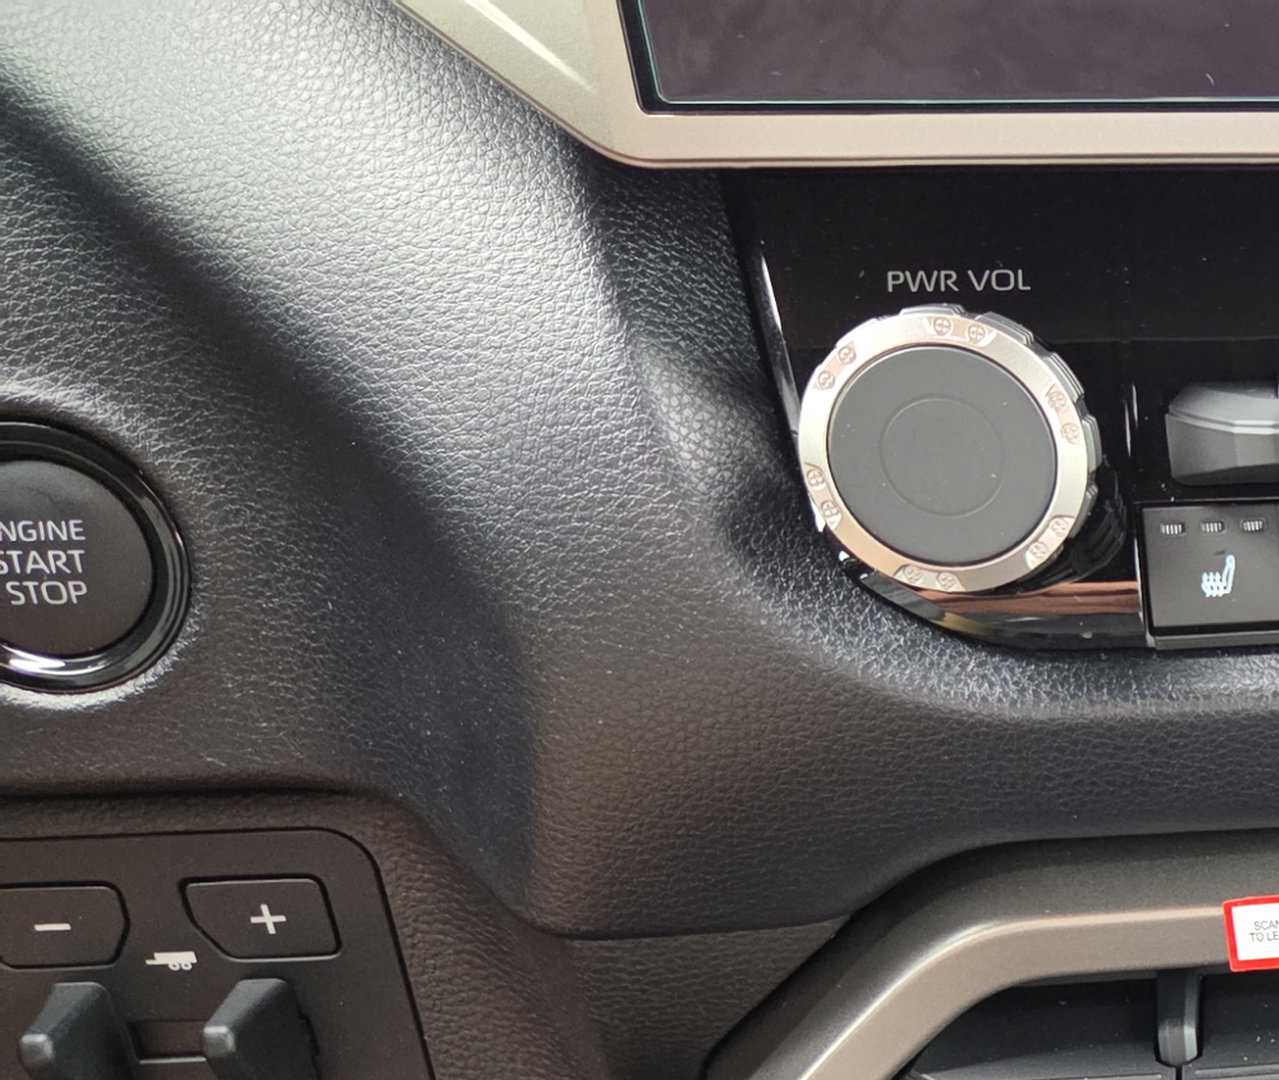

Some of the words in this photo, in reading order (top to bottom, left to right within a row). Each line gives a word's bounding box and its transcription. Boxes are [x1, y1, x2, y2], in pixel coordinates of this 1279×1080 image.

[886, 268, 960, 293] PWR
[968, 267, 1032, 293] VOL
[0, 519, 87, 542] NGINE
[5, 580, 88, 606] STOP
[1249, 932, 1264, 942] TO
